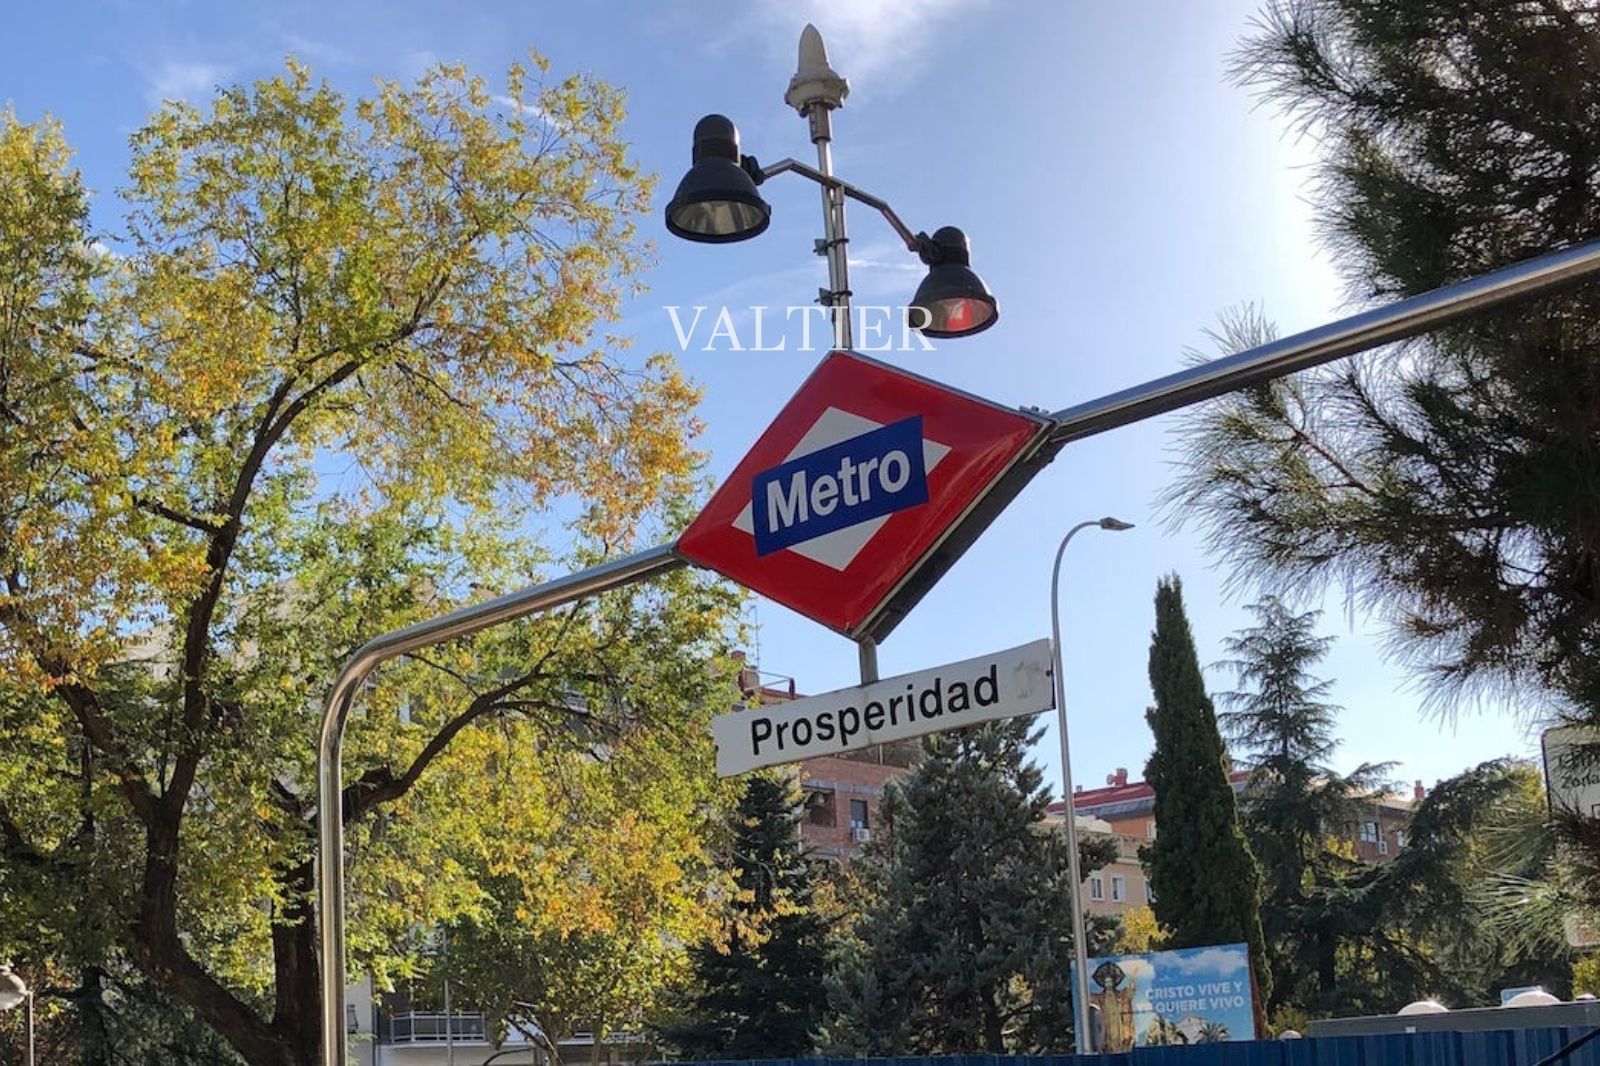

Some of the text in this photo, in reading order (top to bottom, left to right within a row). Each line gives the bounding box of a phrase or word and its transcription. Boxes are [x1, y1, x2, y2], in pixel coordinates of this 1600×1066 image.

[766, 450, 911, 534] Metro
[751, 664, 999, 755] Prosperidad
[1145, 981, 1242, 1000] CRISTO VIVE Y
[1155, 998, 1207, 1013] QUIERE
[1210, 995, 1244, 1009] VIVO
